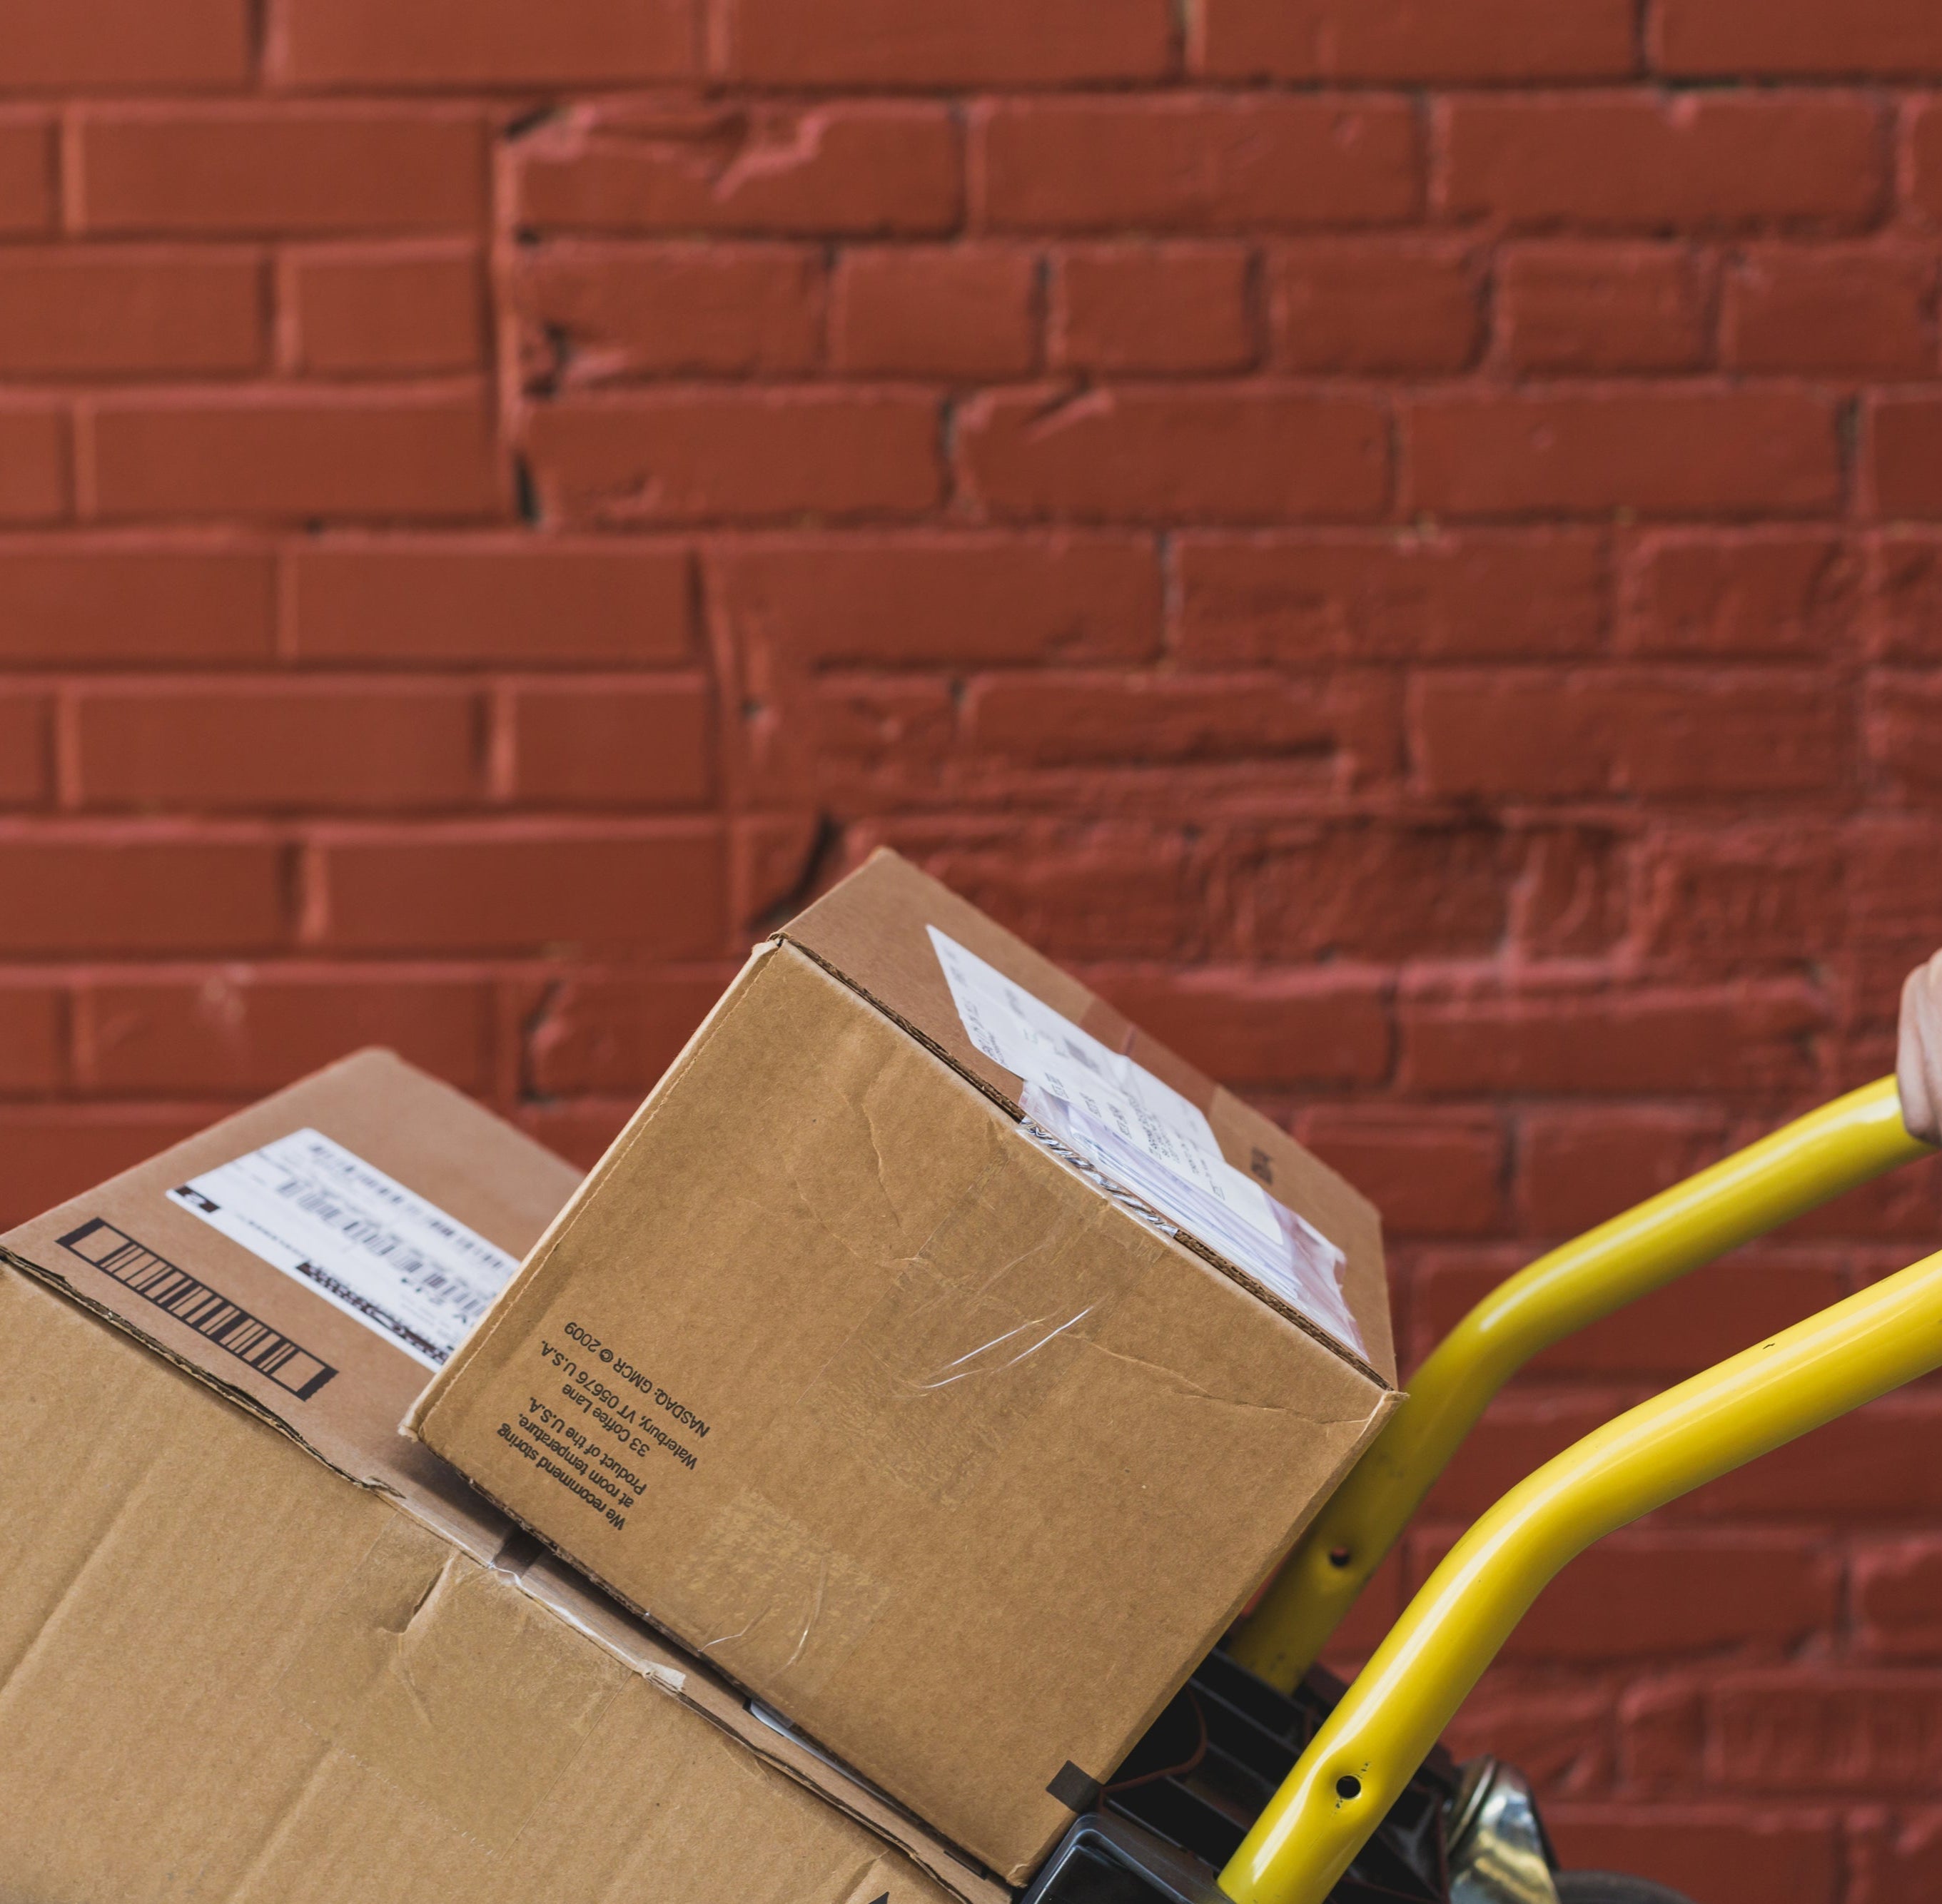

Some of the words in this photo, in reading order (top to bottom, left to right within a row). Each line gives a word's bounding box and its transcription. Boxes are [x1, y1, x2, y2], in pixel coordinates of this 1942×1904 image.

[564, 1322, 602, 1353] 2009
[541, 1340, 577, 1377] U.S.A.
[612, 1357, 653, 1394] GMCR
[562, 1384, 593, 1414] Lane
[575, 1371, 619, 1409] 05676
[529, 1397, 565, 1434] U.S.A.
[592, 1407, 631, 1442] Coffee
[616, 1404, 637, 1424] VT
[654, 1387, 711, 1438] NASDAQ:
[496, 1422, 540, 1461] storing
[518, 1413, 589, 1476] temperature.
[565, 1427, 587, 1449] the
[582, 1444, 601, 1457] of
[629, 1437, 650, 1458] 33
[638, 1415, 698, 1471] Waterbury,
[535, 1456, 607, 1513] recommend
[588, 1469, 621, 1498] room
[599, 1453, 647, 1496] Product
[617, 1492, 634, 1508] at
[605, 1508, 626, 1531] We
